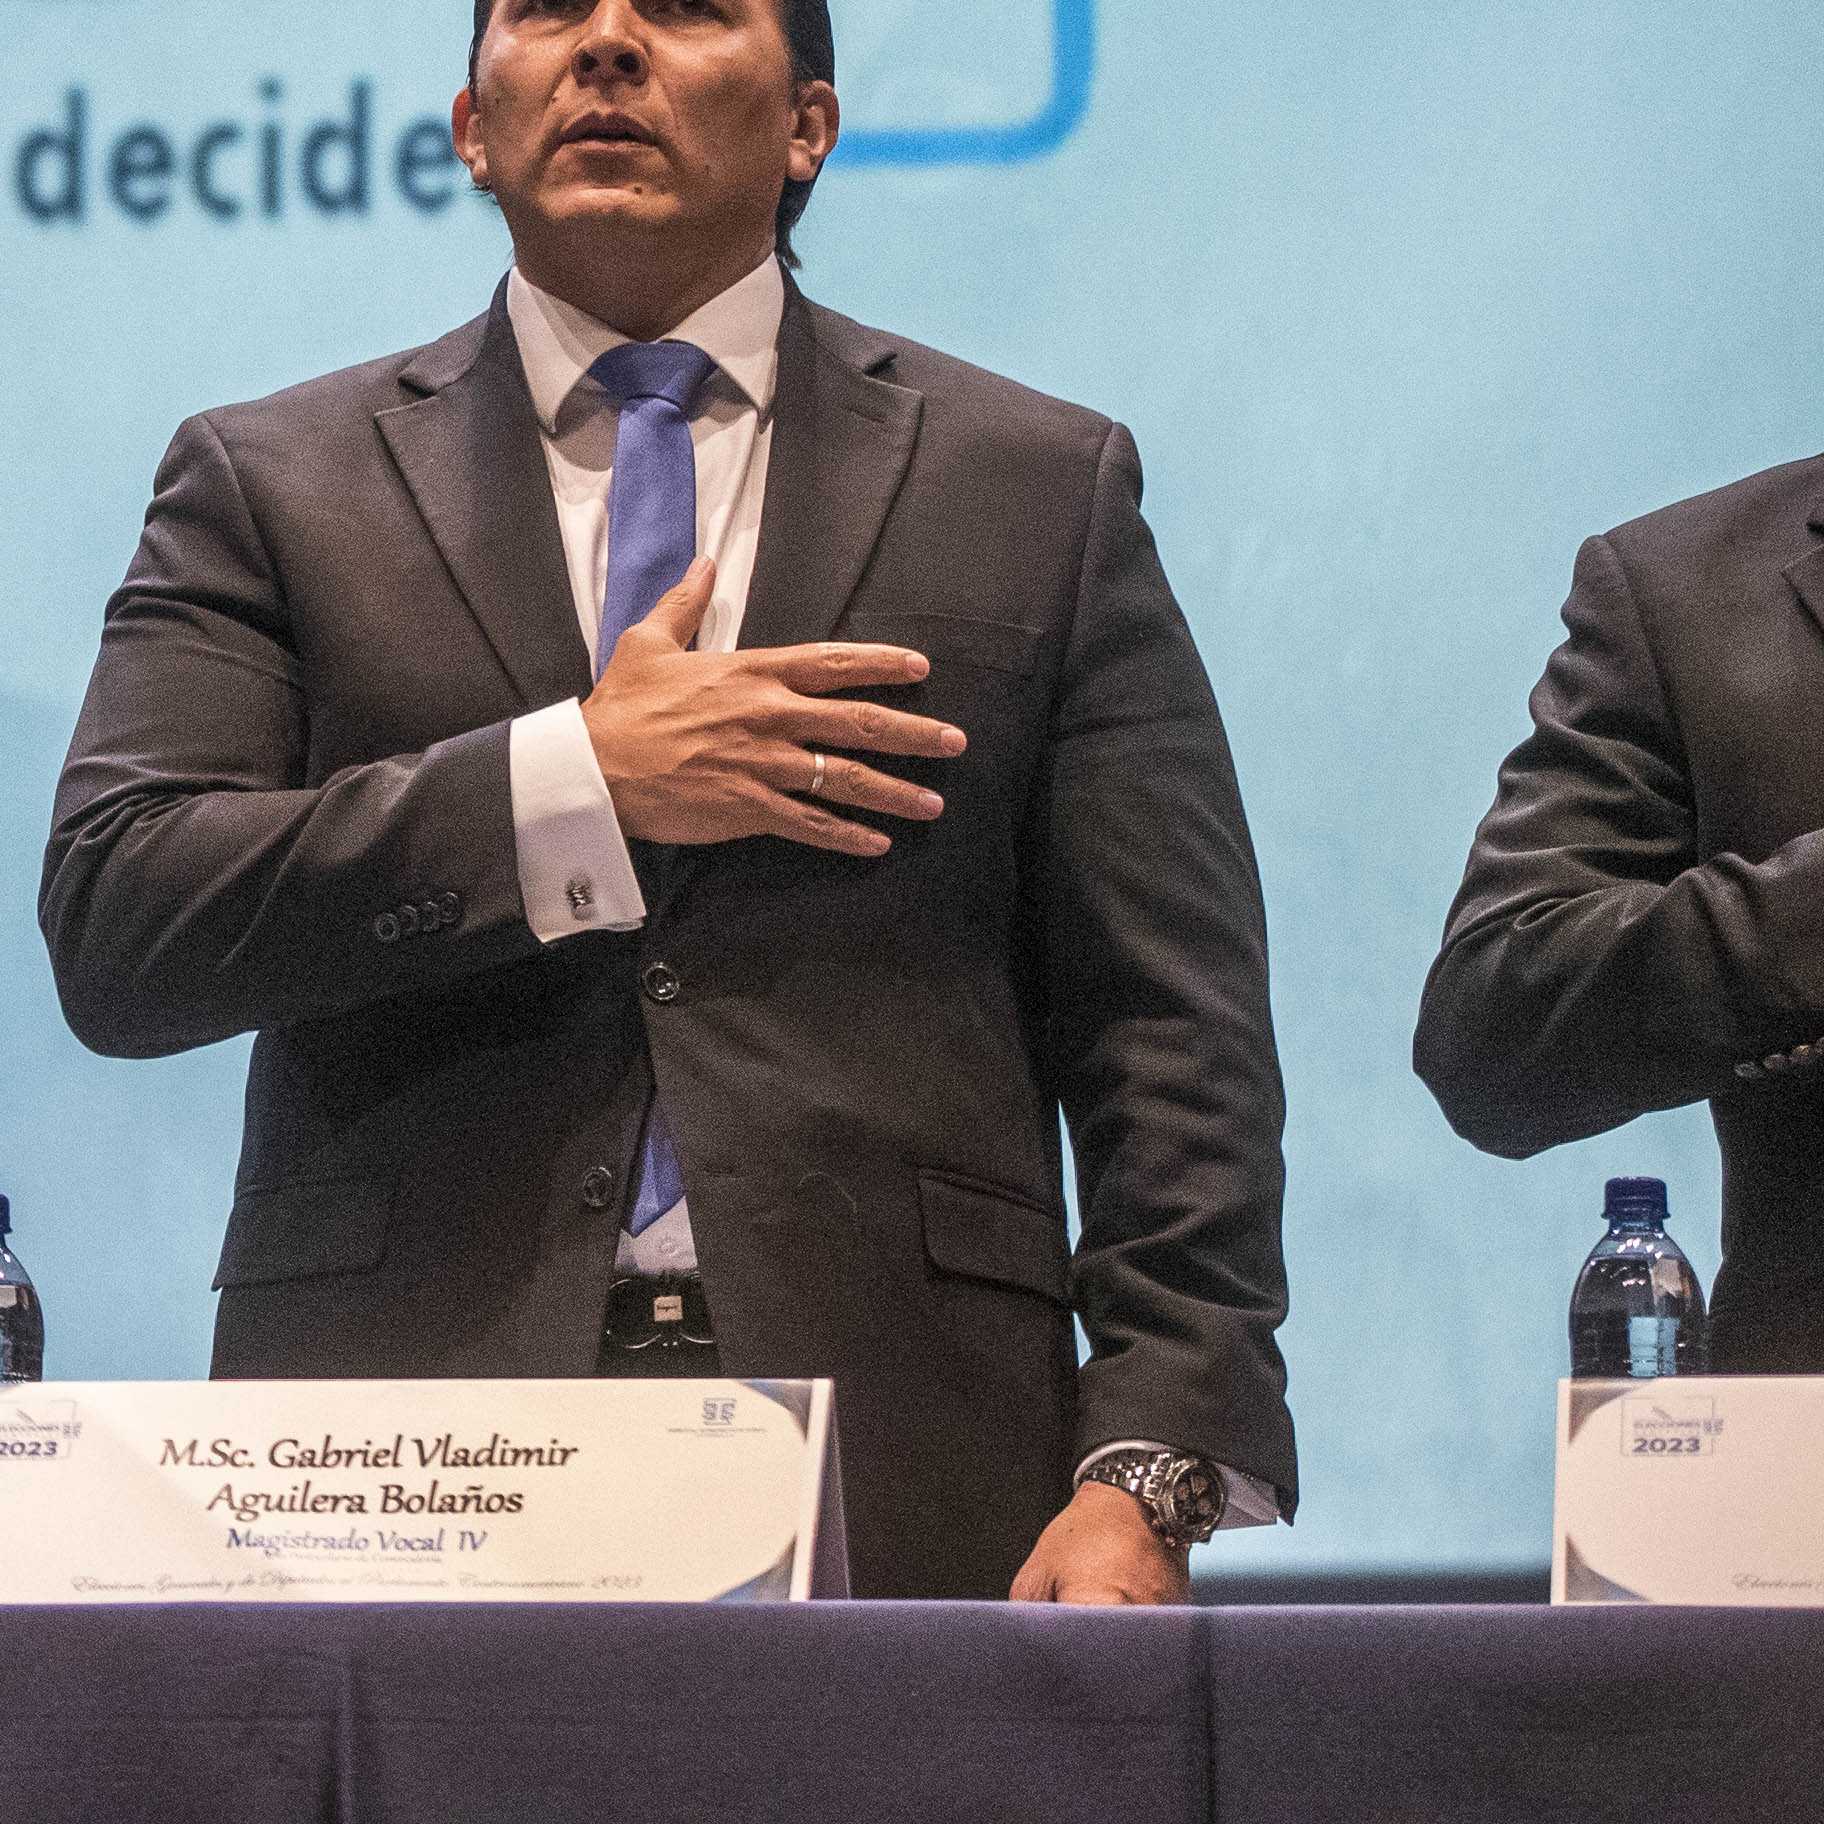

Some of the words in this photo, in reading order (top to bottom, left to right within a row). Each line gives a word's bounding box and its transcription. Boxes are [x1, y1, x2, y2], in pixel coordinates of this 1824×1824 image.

[10, 66, 464, 226] decide
[160, 1438, 255, 1468] M.Sc.
[268, 1433, 403, 1469] Gabriel
[412, 1433, 579, 1468] Vladimir
[1633, 1437, 1701, 1453] 2023
[206, 1479, 368, 1522] Aguilera
[380, 1479, 524, 1514] Bolaños
[224, 1526, 370, 1560] Magistrado
[377, 1527, 445, 1552] Vocal
[459, 1530, 488, 1551] IV
